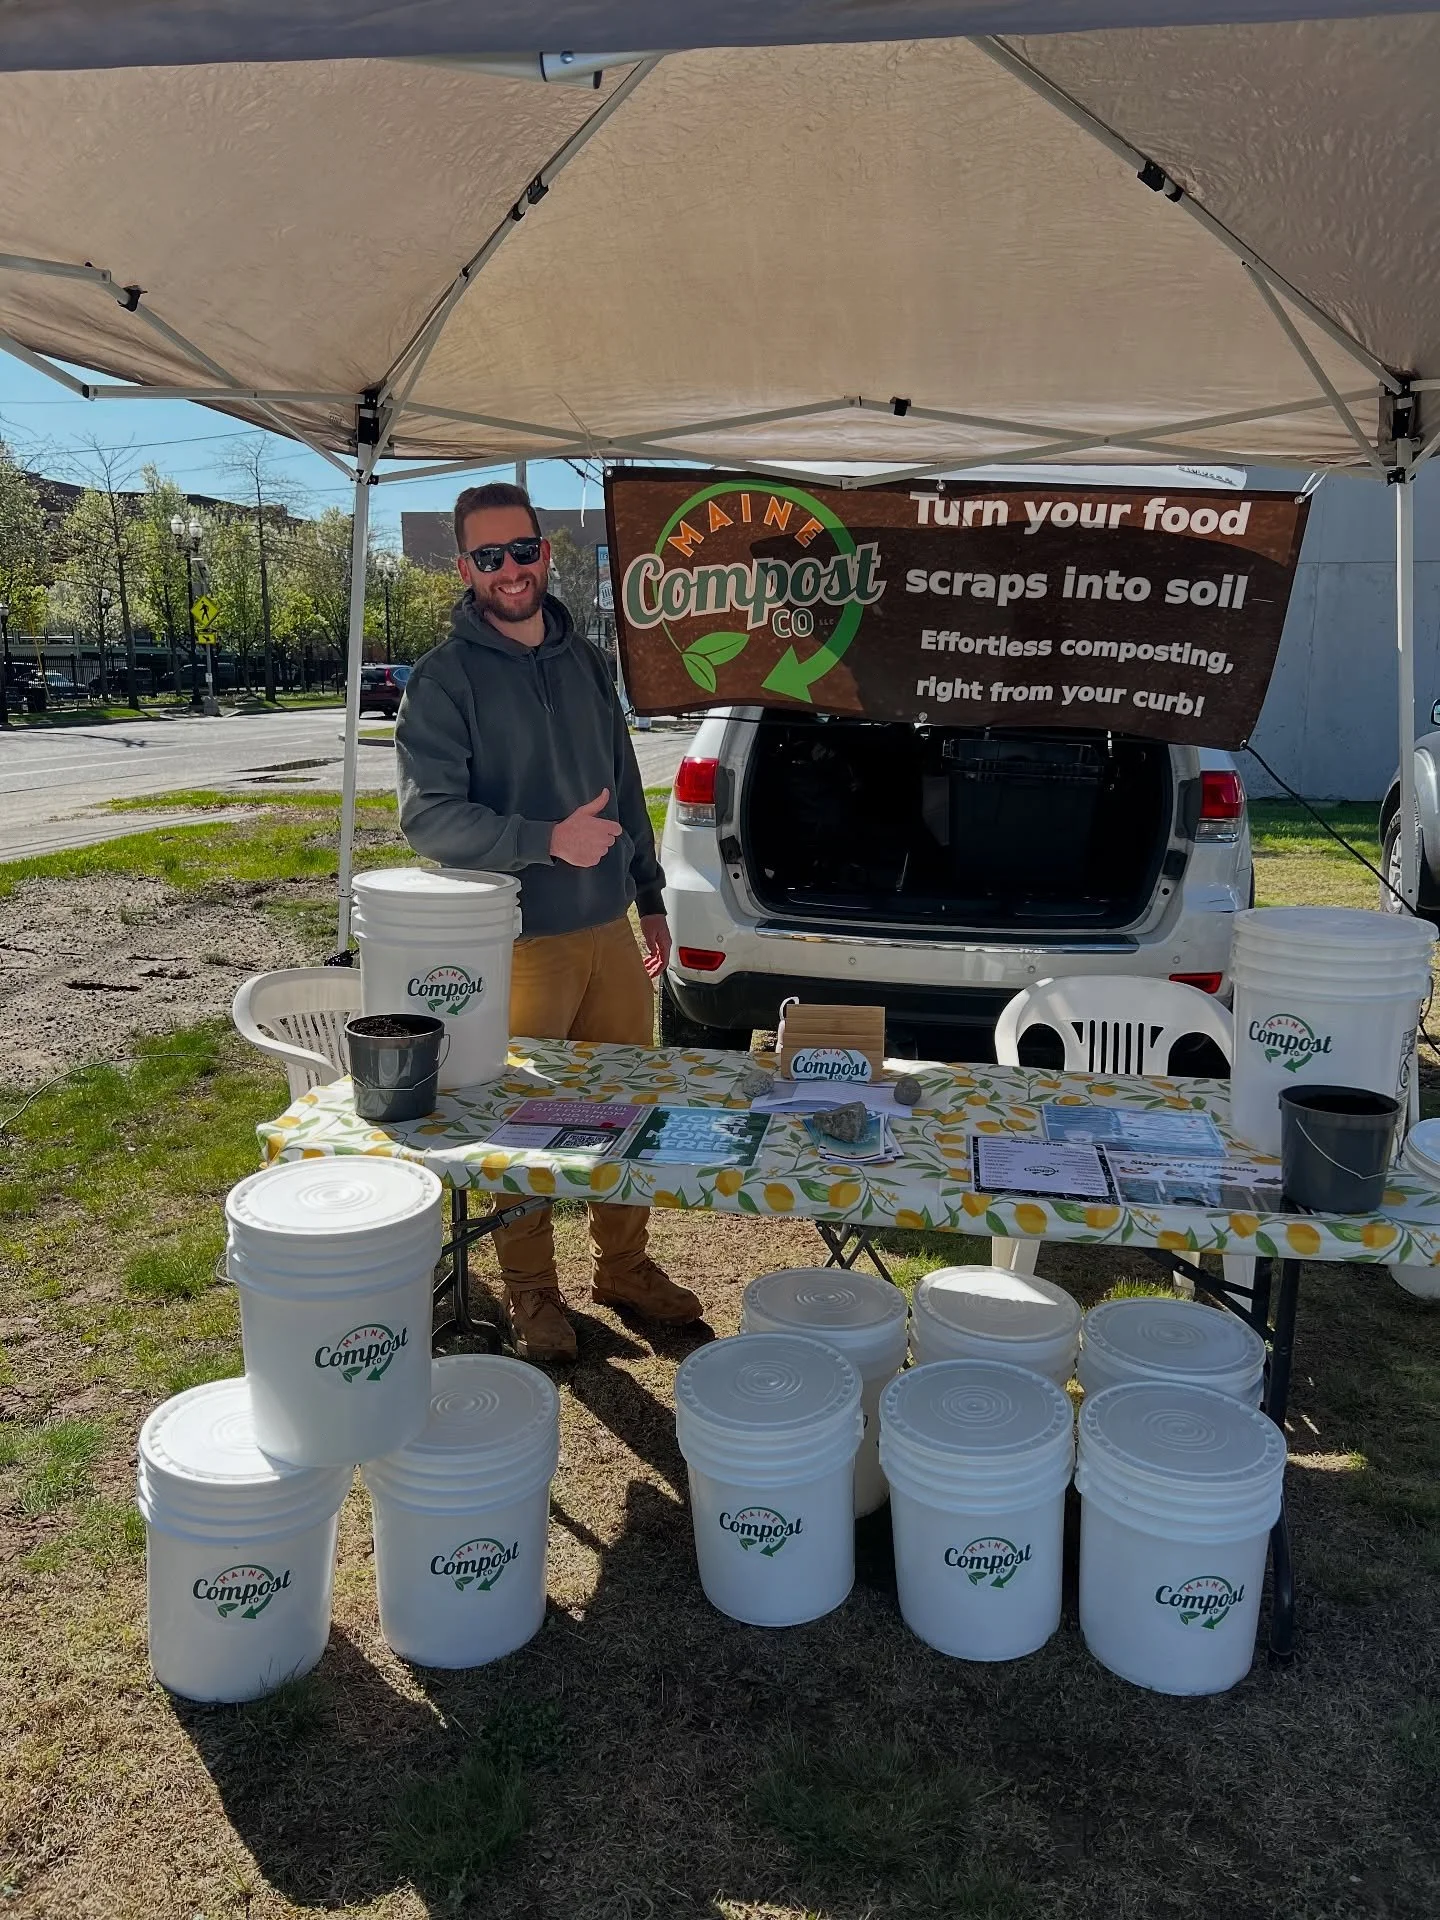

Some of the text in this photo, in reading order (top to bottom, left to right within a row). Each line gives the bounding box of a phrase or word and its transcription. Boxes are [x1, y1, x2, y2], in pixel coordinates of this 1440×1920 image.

[668, 493, 825, 557] MAINE
[909, 491, 1252, 536] Turn your food
[623, 542, 887, 630] Compost
[905, 565, 1248, 609] scraps into soil
[772, 608, 814, 638] CO
[920, 629, 1234, 675] Effortless composting,
[916, 676, 1205, 717] right from your curb!
[407, 976, 483, 1001] Compost
[429, 970, 464, 982] MAINE
[1249, 1020, 1333, 1054] Compost
[1267, 1018, 1306, 1035] MAINE
[793, 1056, 867, 1079] Compost
[814, 1049, 847, 1061] MAINE
[660, 1140, 730, 1151] FREE
[1130, 1159, 1170, 1167] Stages
[1188, 1163, 1259, 1174] Composting
[314, 1326, 408, 1368] Compost
[342, 1329, 385, 1348] MAINE
[719, 1512, 803, 1542] Compost
[740, 1511, 779, 1524] MAINE
[430, 1541, 520, 1578] Compost
[456, 1543, 497, 1559] MAINE
[944, 1543, 1032, 1575] Compost
[968, 1541, 1009, 1553] MAINE
[193, 1569, 291, 1605] Compost
[219, 1569, 264, 1584] MAINE
[1184, 1580, 1225, 1593] MAINE
[1155, 1584, 1245, 1615] Compost
